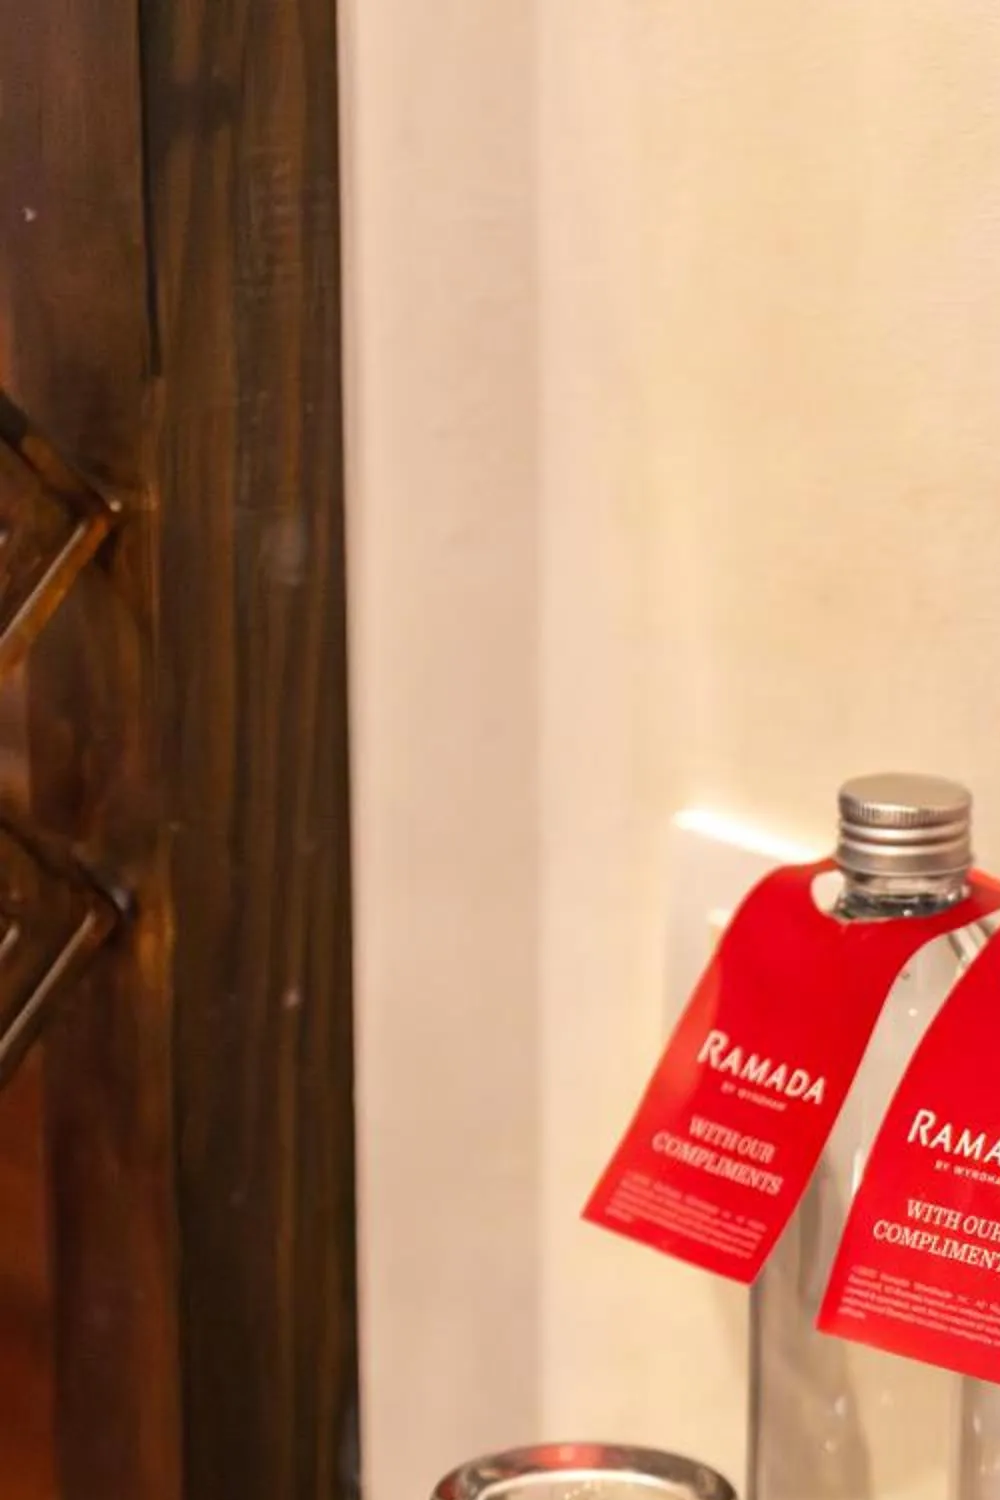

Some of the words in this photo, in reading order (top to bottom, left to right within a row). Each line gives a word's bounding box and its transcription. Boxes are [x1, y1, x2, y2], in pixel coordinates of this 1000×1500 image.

[697, 1029, 826, 1105] RAMADA
[652, 1131, 784, 1196] COMPLIMENTS
[689, 1114, 740, 1151] WITH
[737, 1136, 775, 1164] OUR
[906, 1199, 963, 1231] WITH
